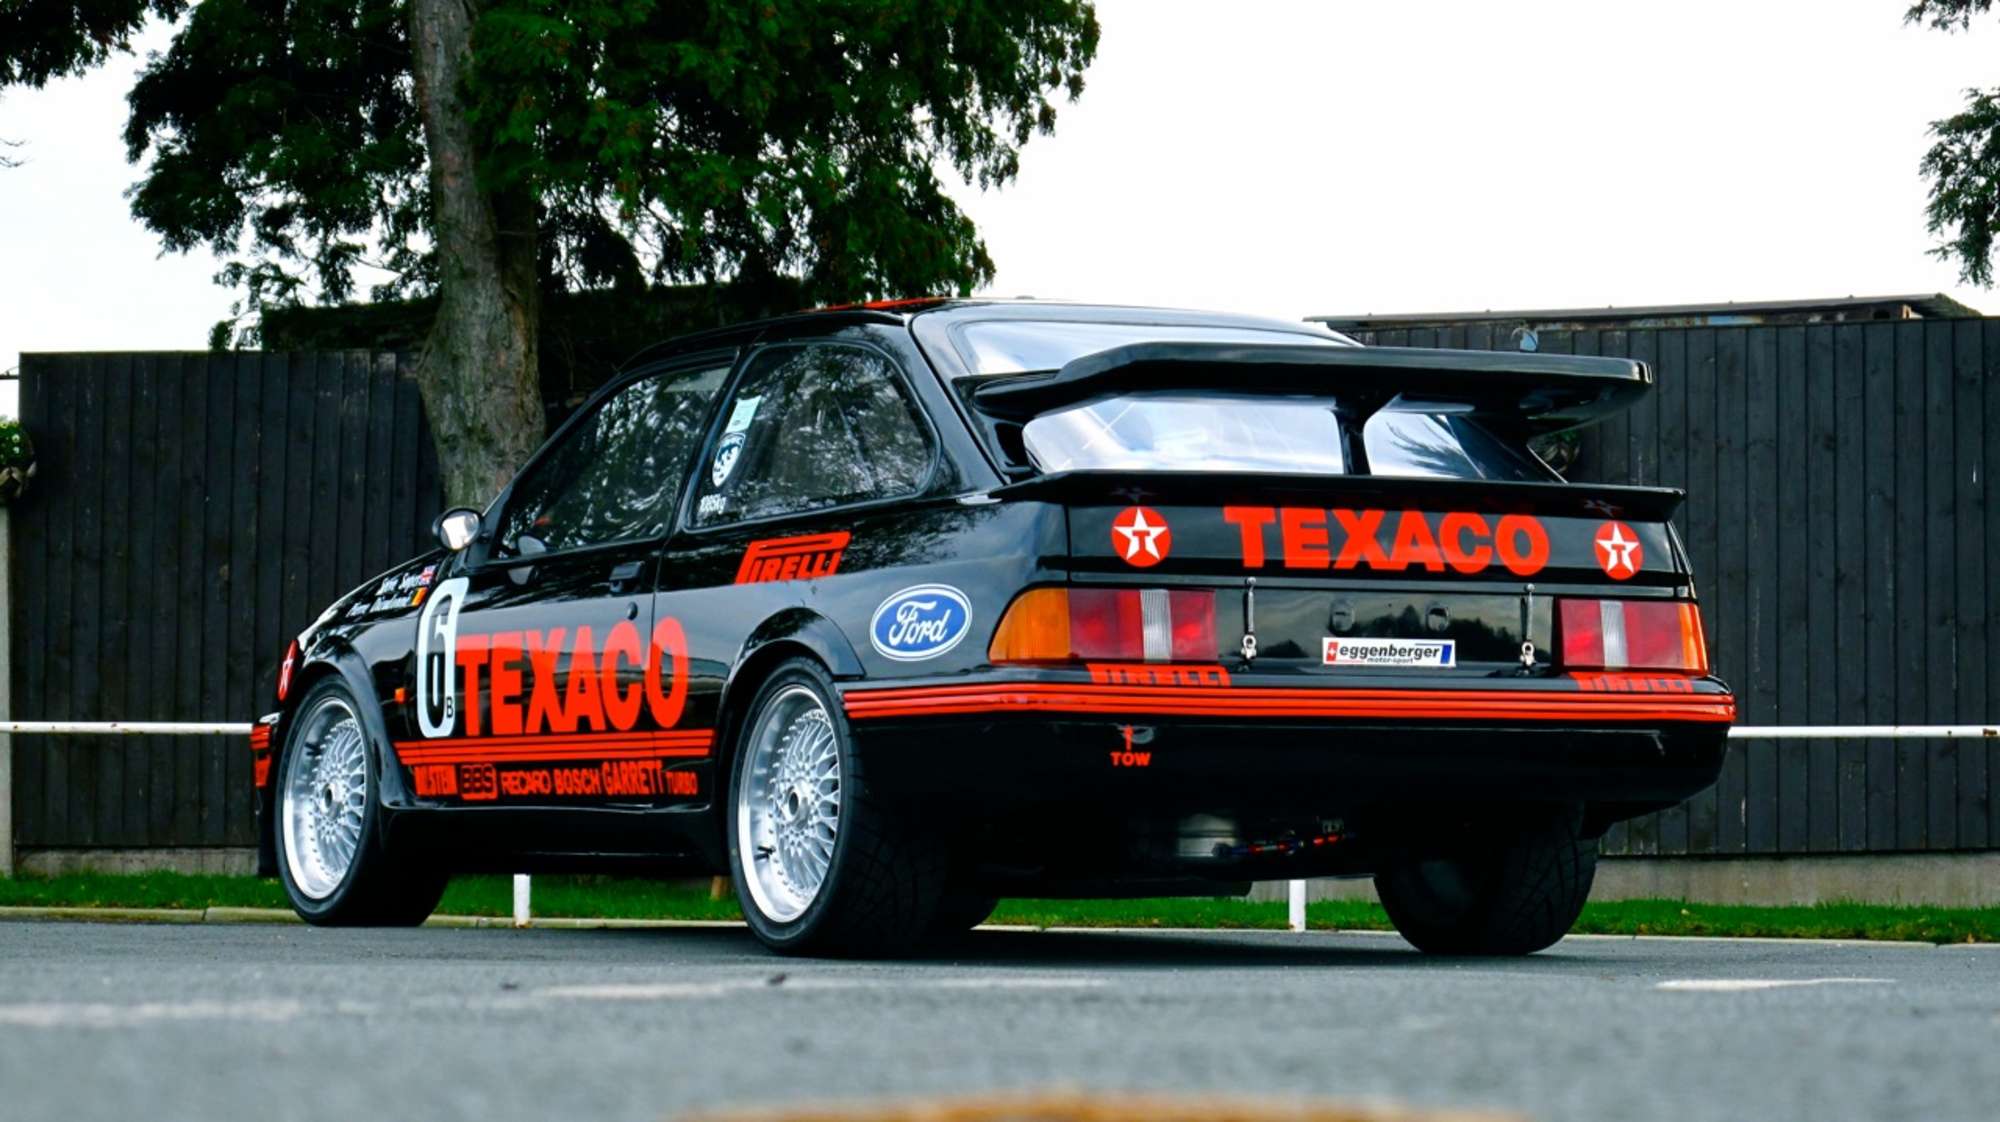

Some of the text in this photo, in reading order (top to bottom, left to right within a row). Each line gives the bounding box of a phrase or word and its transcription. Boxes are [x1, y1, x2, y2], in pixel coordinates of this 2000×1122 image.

[735, 531, 850, 584] PIRELLI
[1223, 505, 1549, 576] TEXACO
[889, 601, 951, 646] Ford
[417, 577, 469, 738] 6
[1339, 644, 1440, 661] eggenberger
[455, 616, 689, 737] TEXACO
[446, 697, 454, 718] B
[461, 763, 498, 800] BBS
[501, 770, 551, 795] RECARO
[553, 768, 602, 795] BOSCH
[602, 759, 664, 795] GARRETT
[665, 771, 697, 795] TURBO
[1110, 752, 1151, 766] TOW
